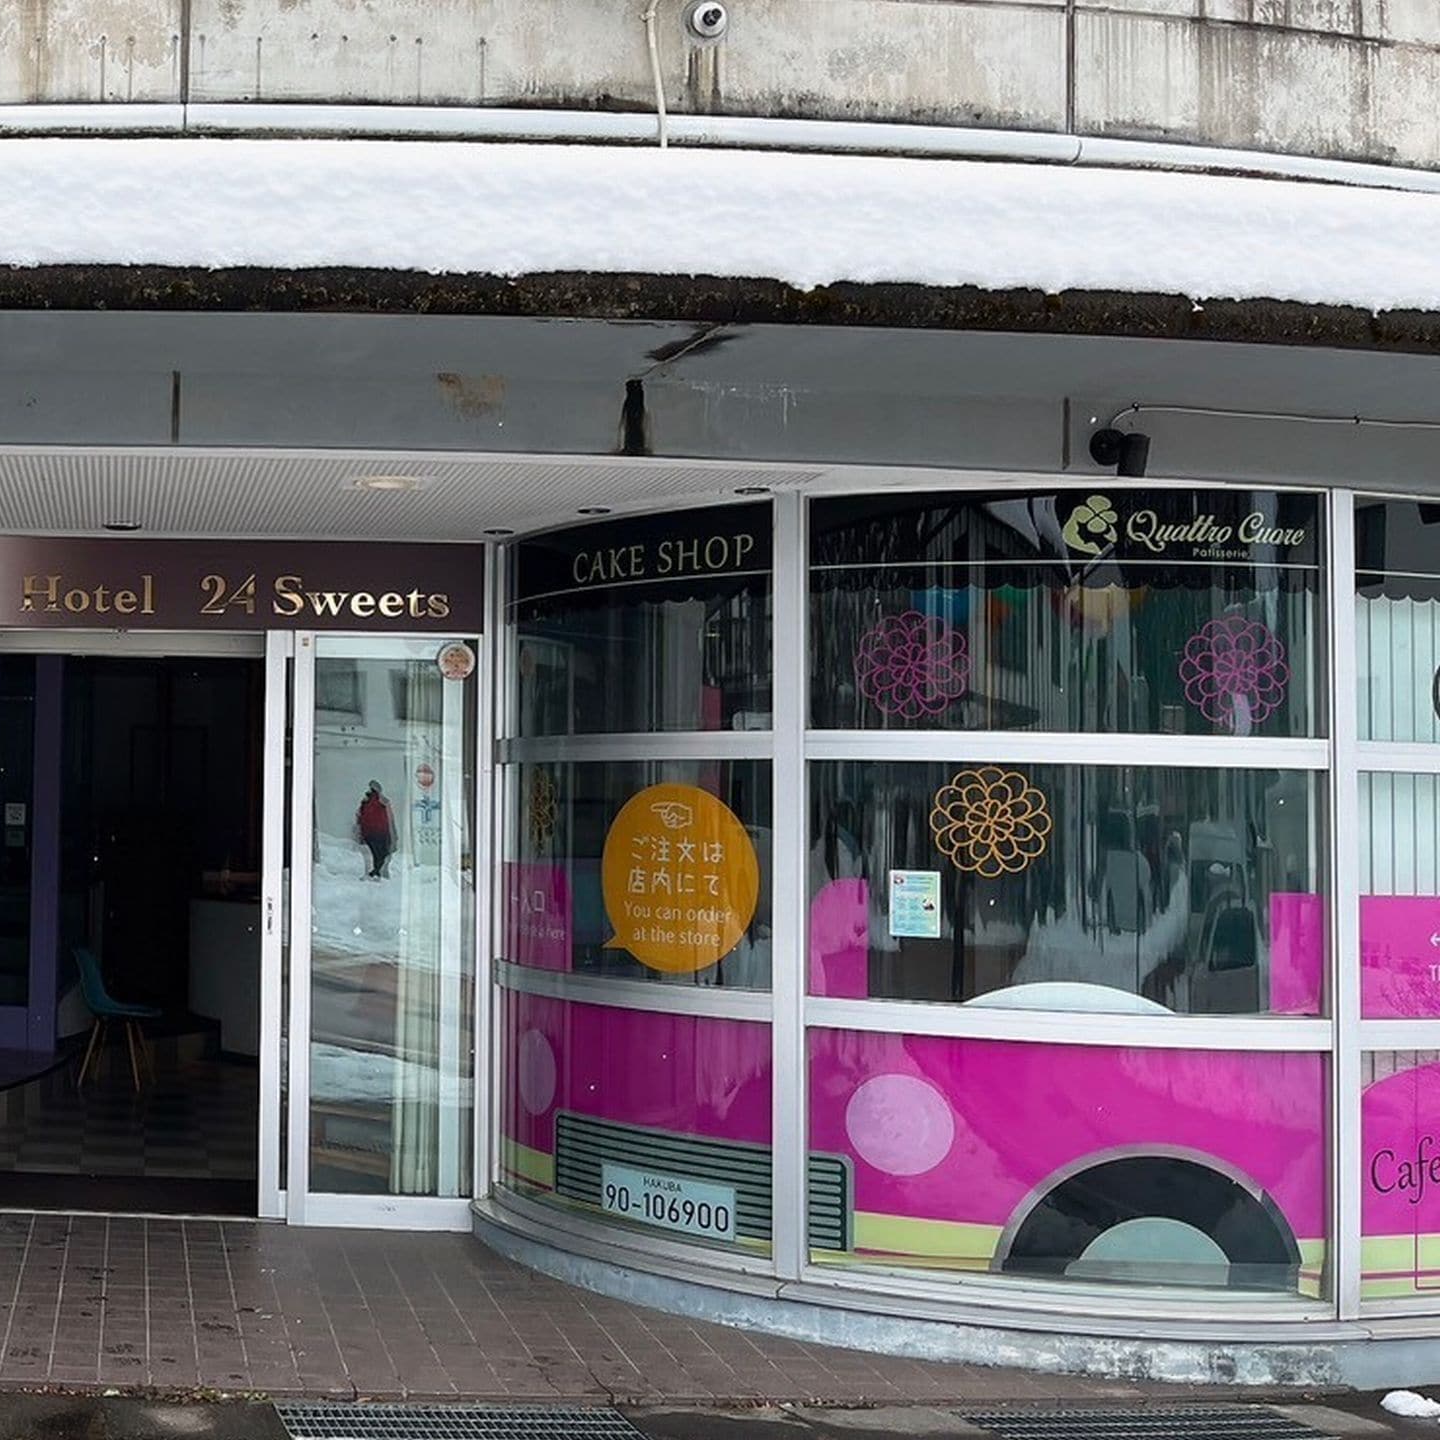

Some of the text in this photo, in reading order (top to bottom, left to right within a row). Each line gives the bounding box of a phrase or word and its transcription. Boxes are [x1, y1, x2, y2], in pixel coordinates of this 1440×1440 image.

[1127, 510, 1232, 552] Quattro
[573, 534, 754, 583] CAKE SHOP
[20, 574, 450, 617] Hotel 24 Sweets
[631, 836, 726, 864] ご注文は
[627, 868, 720, 897] 店内にて
[624, 900, 732, 925] You can order
[633, 926, 721, 948] at the store
[643, 1177, 682, 1193] HAKUBA
[606, 1184, 729, 1232] 90-106900
